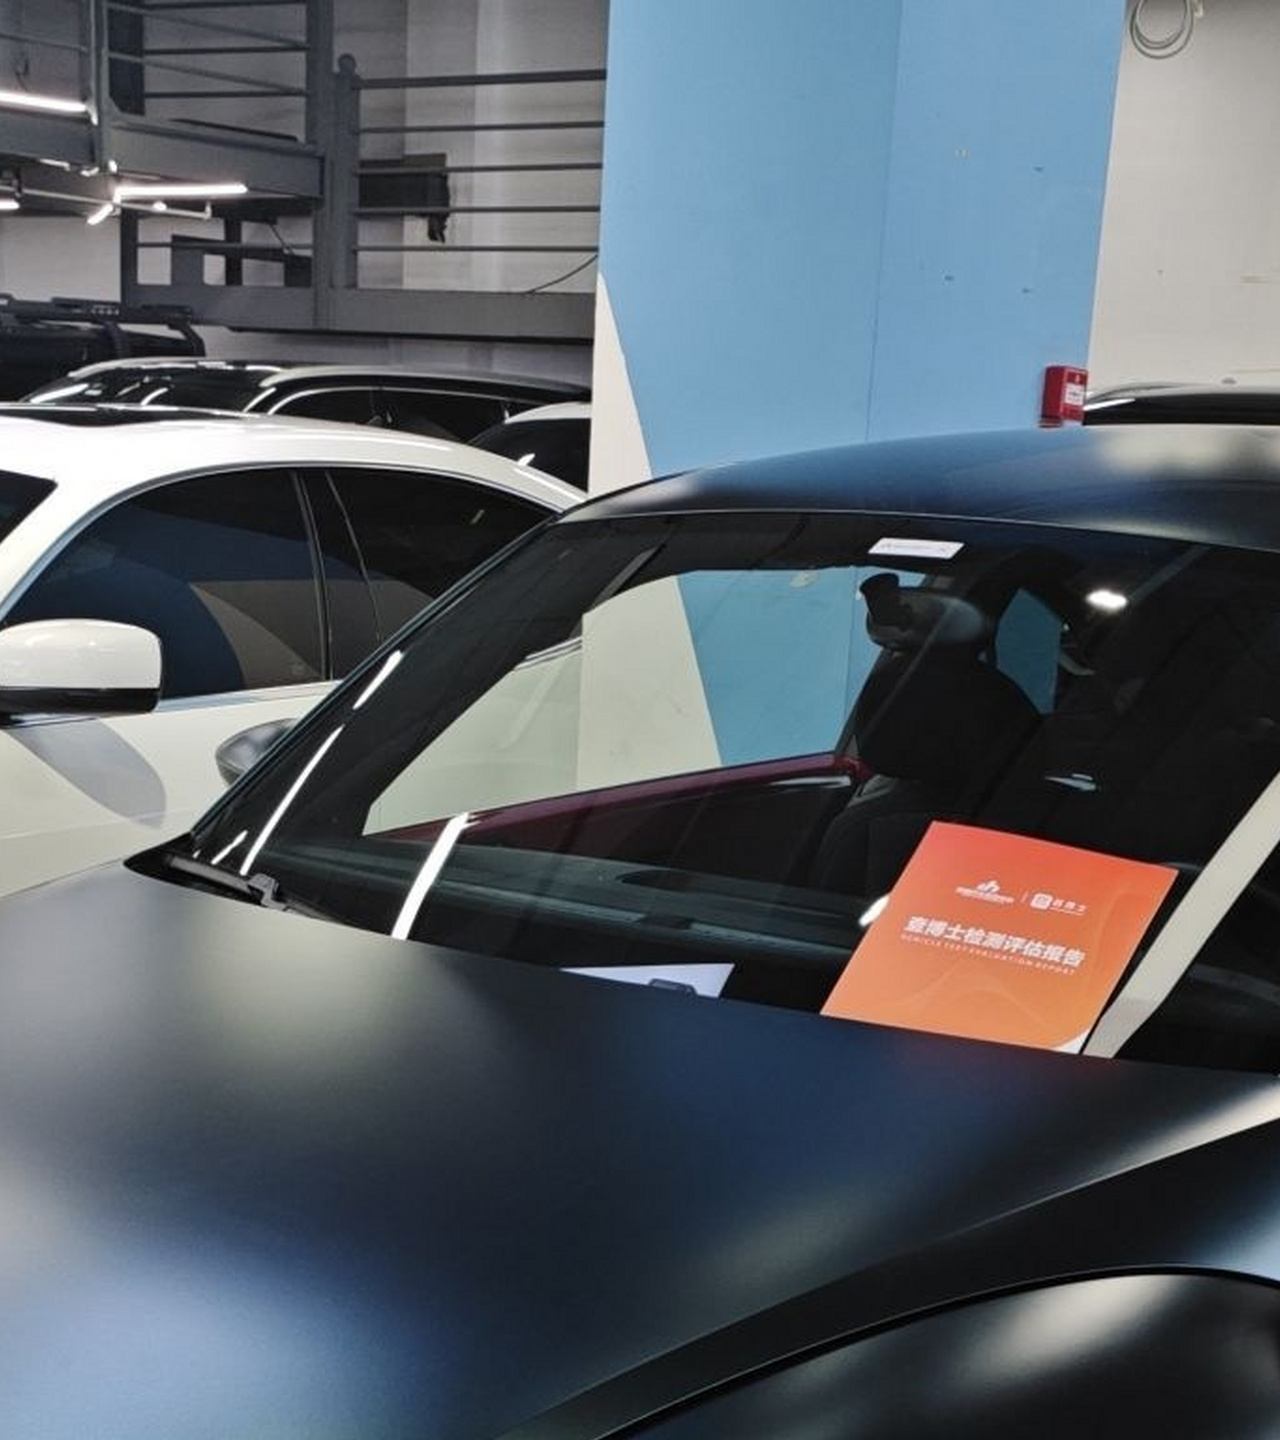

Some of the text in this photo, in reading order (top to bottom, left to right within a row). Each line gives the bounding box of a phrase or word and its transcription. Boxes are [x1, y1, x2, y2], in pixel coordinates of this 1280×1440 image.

[904, 915, 1086, 968] 查博士检测评估报告
